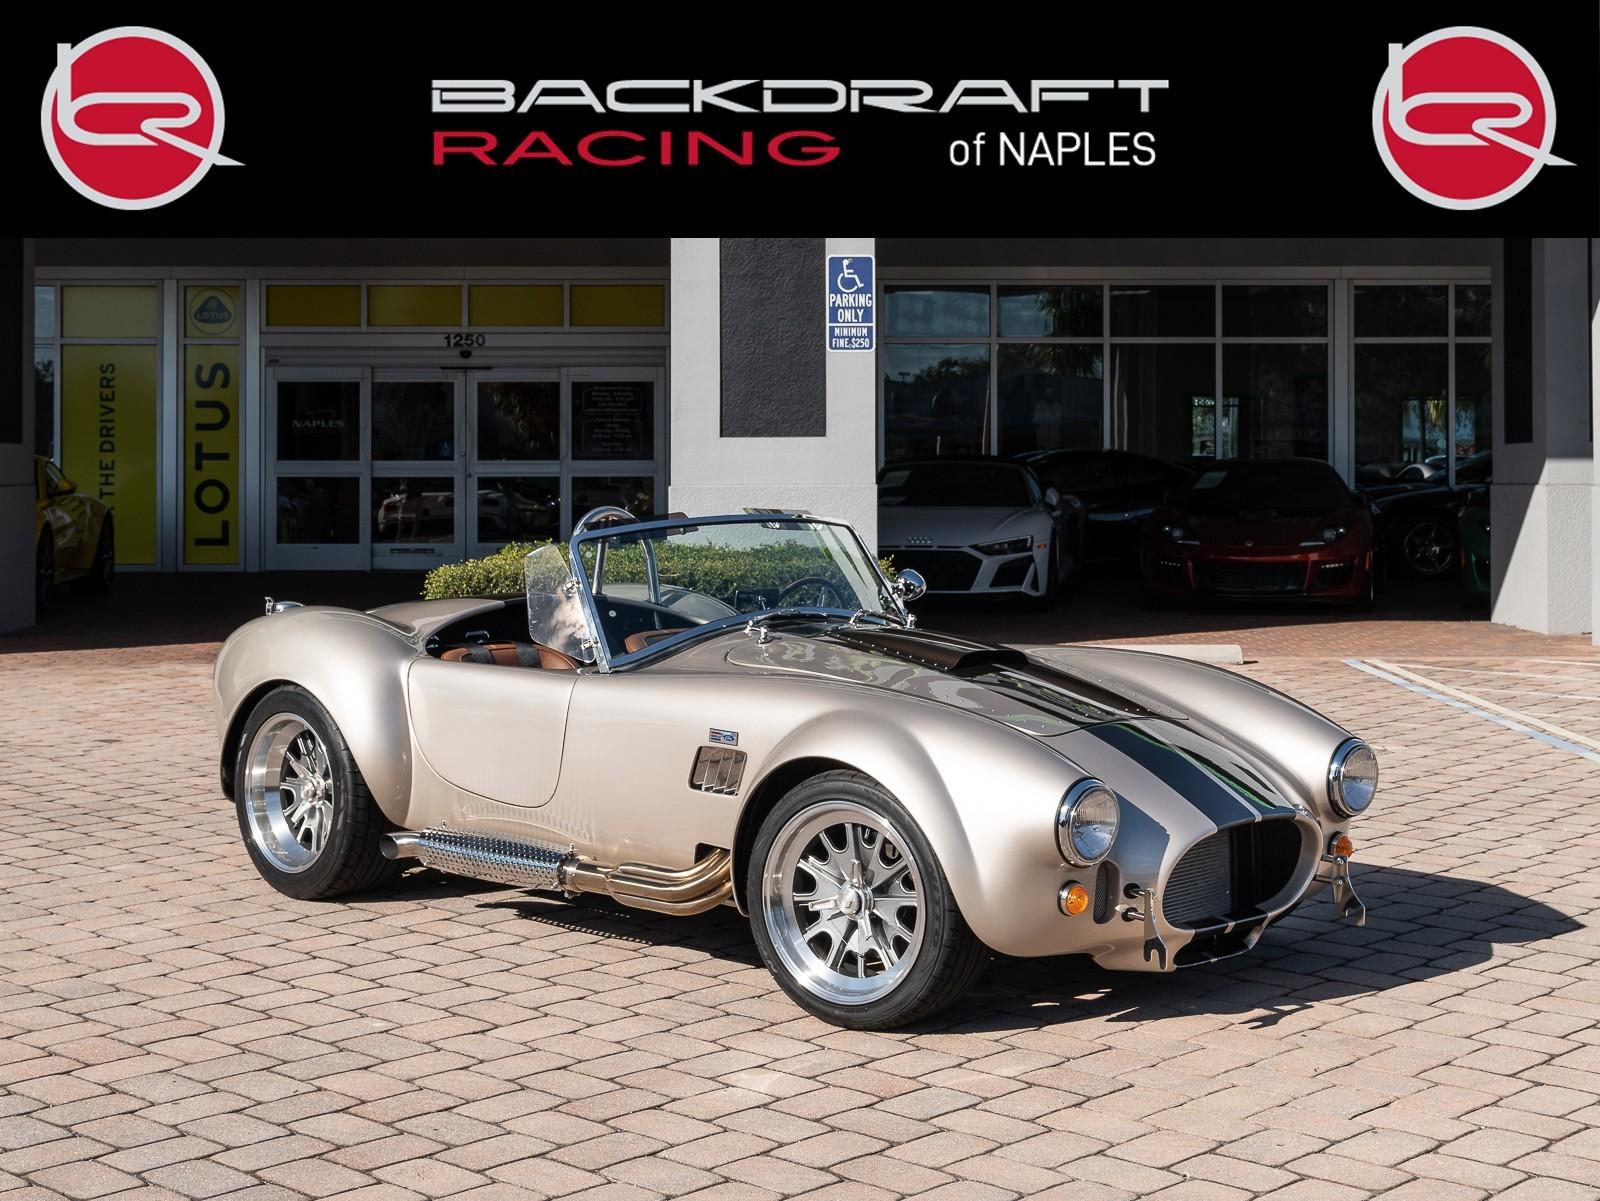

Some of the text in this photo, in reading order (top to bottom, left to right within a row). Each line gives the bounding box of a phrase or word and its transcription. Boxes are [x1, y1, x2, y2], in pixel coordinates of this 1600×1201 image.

[830, 294, 872, 307] PARKING
[196, 311, 230, 321] LOTUS
[838, 309, 863, 322] ONLY
[834, 327, 868, 337] MINIMUM
[443, 333, 486, 348] 1250
[832, 338, 869, 348] FINE $250
[98, 362, 115, 453] DRIVERS
[291, 419, 345, 428] NAPLES
[195, 362, 230, 546] LOTUS
[98, 459, 115, 499] THE
